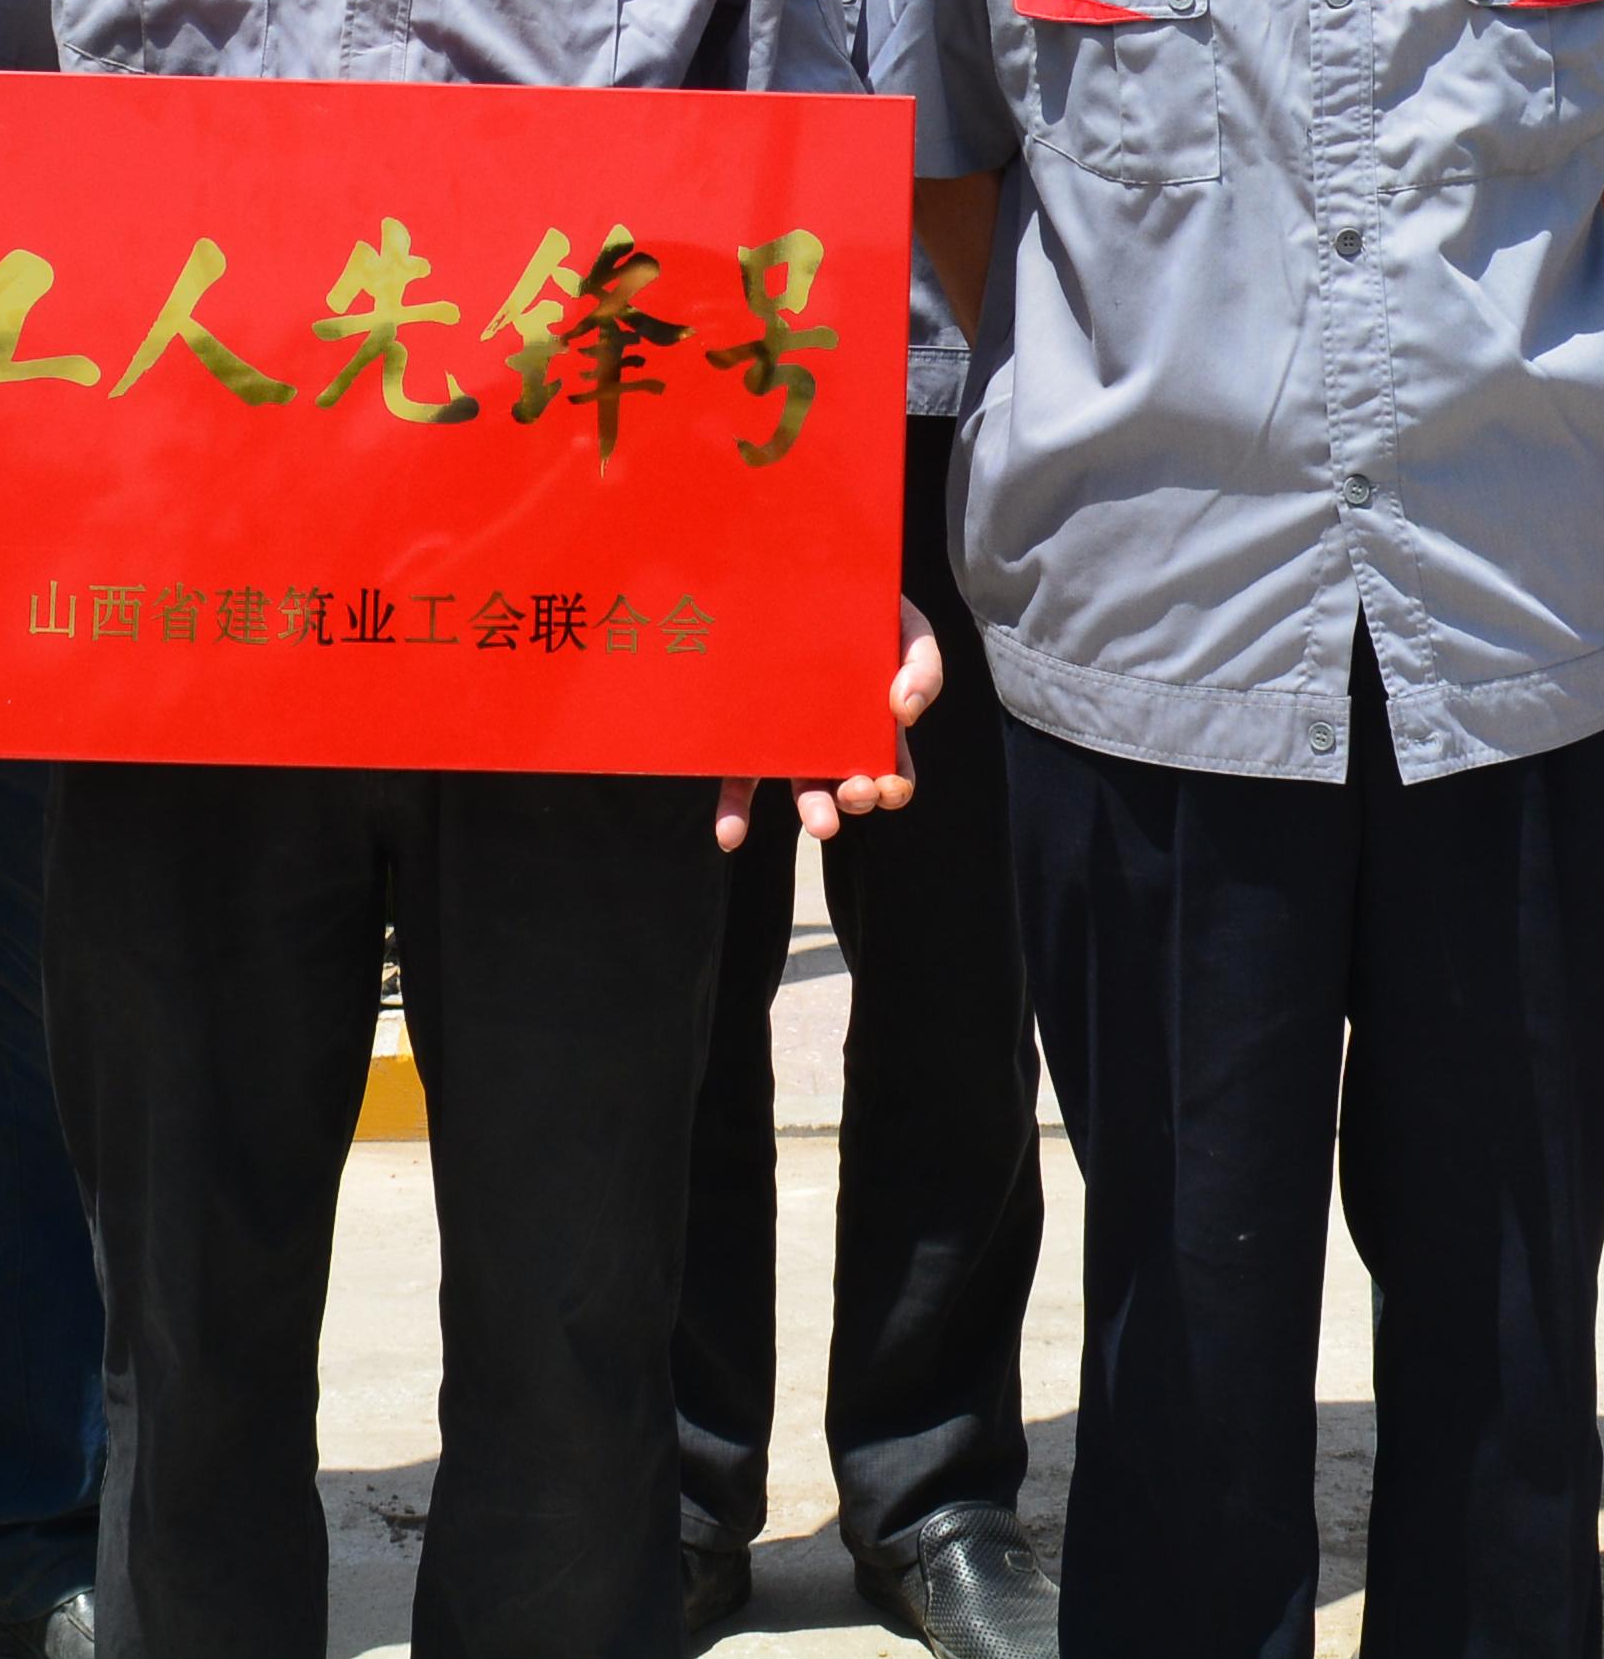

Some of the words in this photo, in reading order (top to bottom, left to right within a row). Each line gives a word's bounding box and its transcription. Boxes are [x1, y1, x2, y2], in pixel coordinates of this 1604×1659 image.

[28, 580, 716, 655] 山西省建筑业工会联合会
